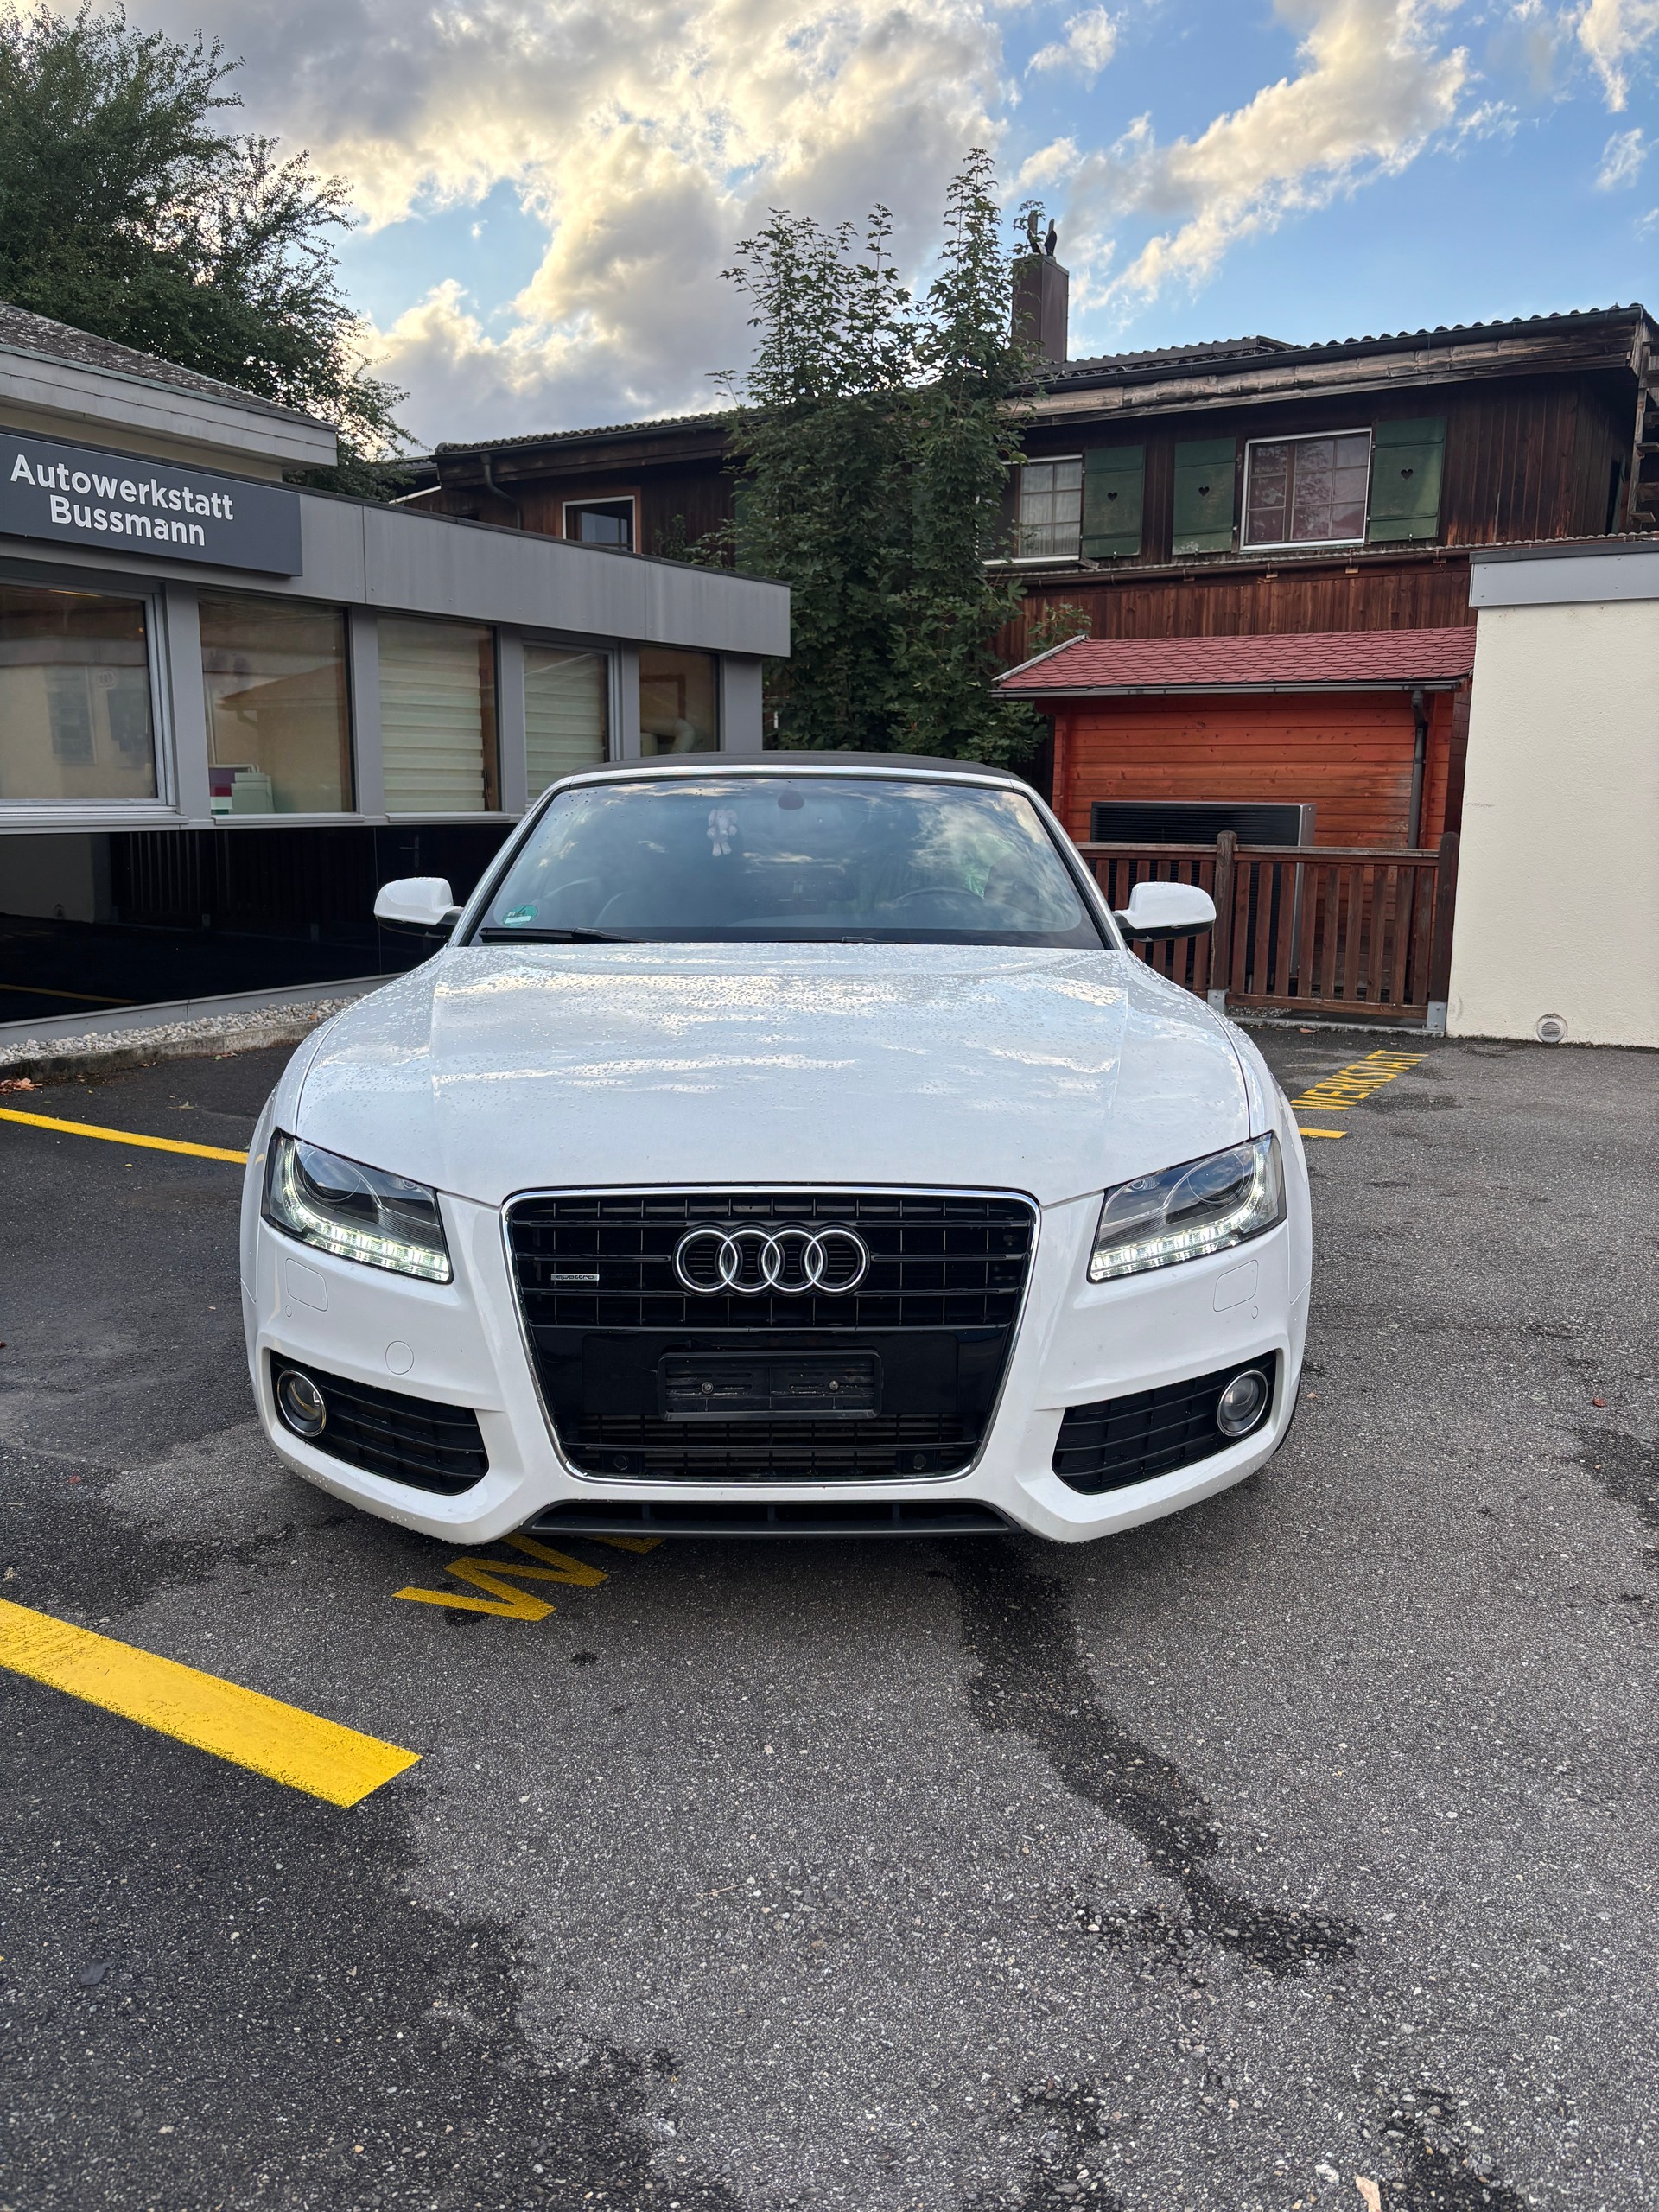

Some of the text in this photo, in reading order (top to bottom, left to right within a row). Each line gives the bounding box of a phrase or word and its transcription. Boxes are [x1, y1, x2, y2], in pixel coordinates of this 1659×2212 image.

[10, 454, 233, 520] Autowerkstatt
[50, 494, 206, 546] Bussmann
[1290, 1050, 1429, 1110] WERKSTATT
